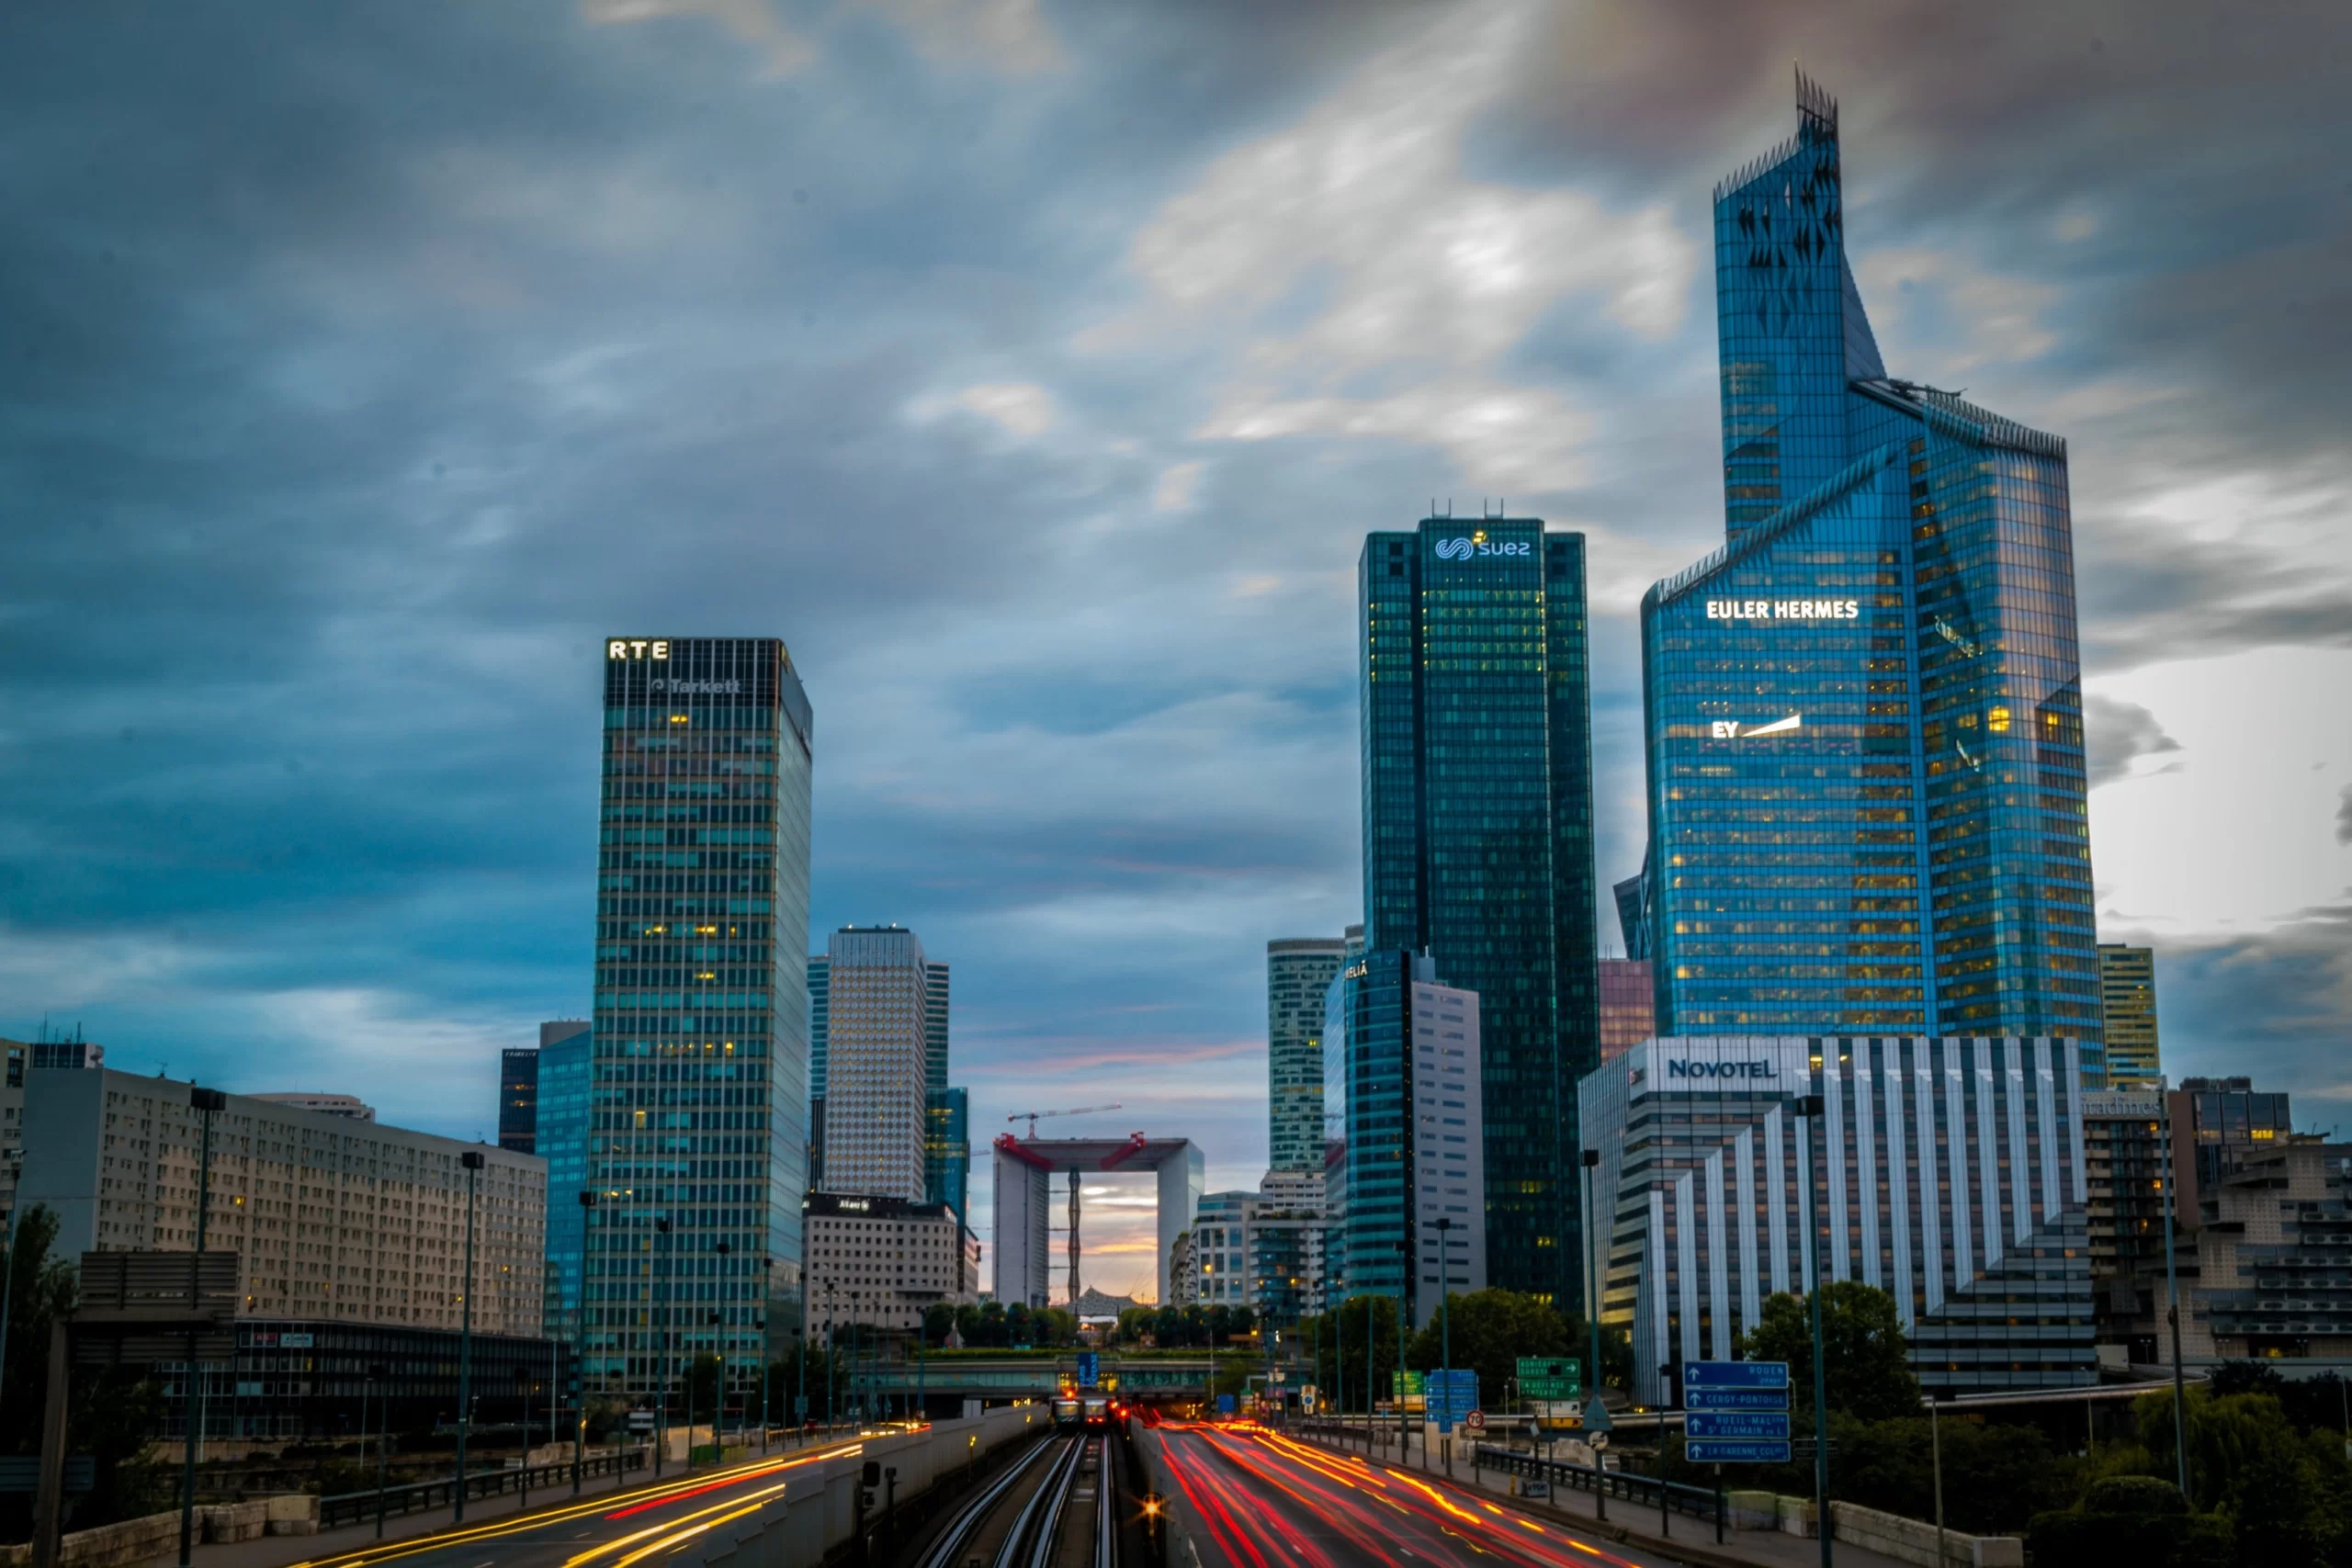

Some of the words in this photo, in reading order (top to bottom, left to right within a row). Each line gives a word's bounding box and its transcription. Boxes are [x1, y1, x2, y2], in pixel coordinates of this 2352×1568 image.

[1477, 542, 1531, 556] suez
[1706, 600, 1770, 619] EULER
[1774, 600, 1860, 619] HERMES
[608, 640, 669, 660] RTE
[670, 678, 741, 694] Tarkett
[1712, 720, 1739, 739] EY
[1749, 1366, 1784, 1375] ROUEN
[1706, 1394, 1784, 1404] CERGY-PONTOISE
[1471, 1415, 1481, 1424] 70
[1721, 1426, 1763, 1435] GERMAIN
